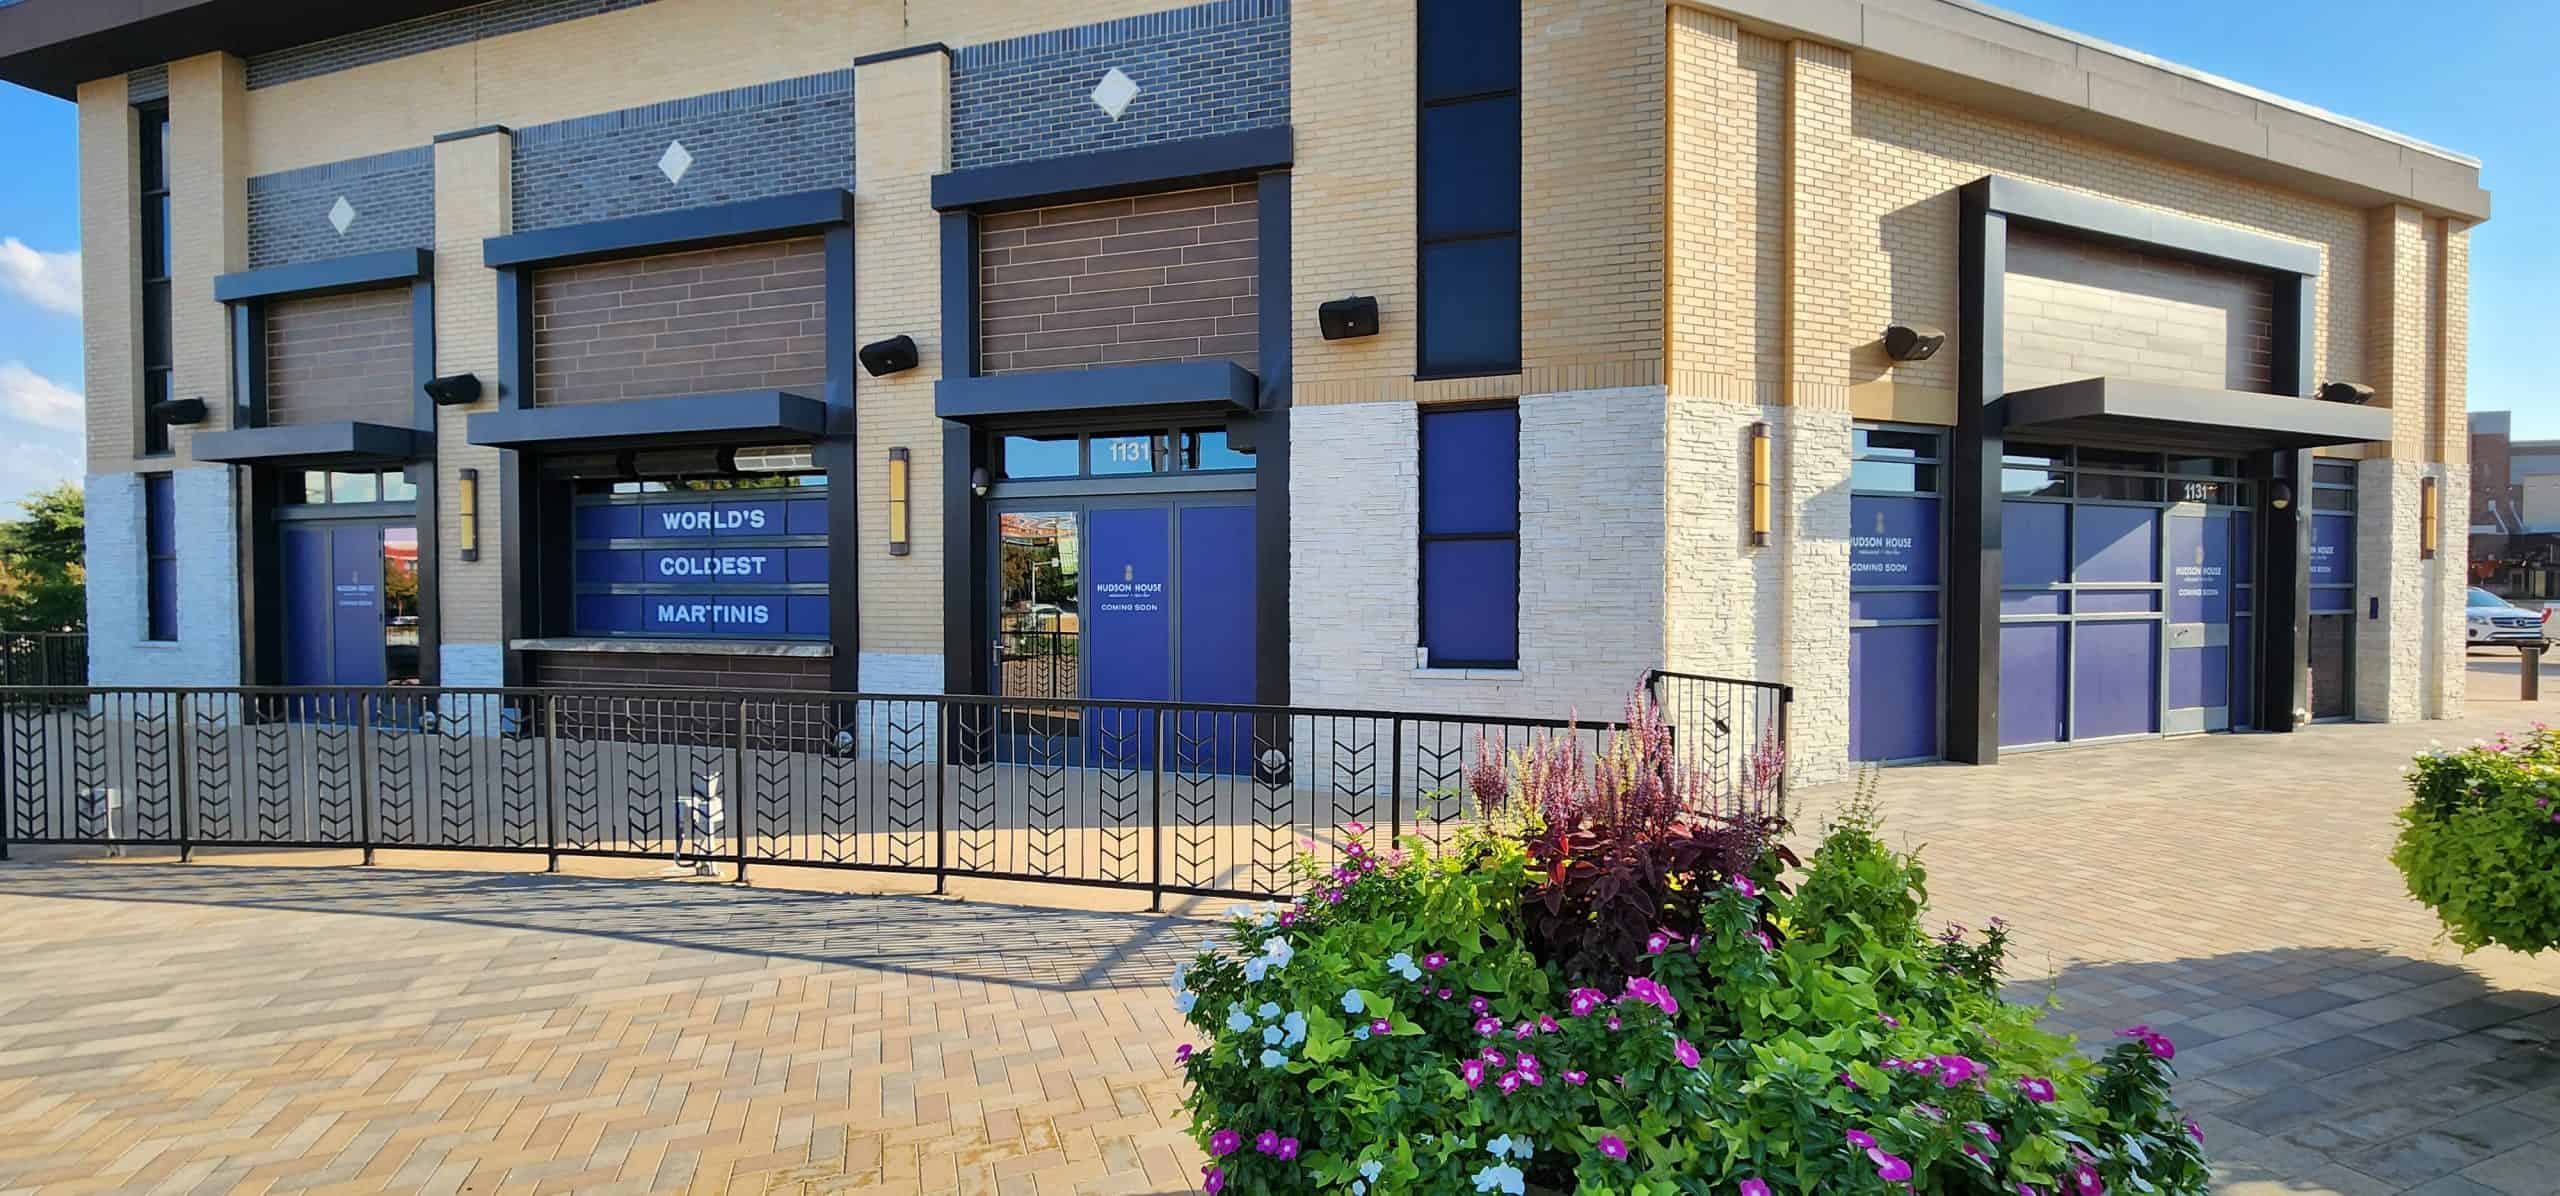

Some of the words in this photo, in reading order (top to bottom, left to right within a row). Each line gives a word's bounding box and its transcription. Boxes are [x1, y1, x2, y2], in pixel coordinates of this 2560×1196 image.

[1110, 442, 1150, 463] 1131
[2184, 483, 2207, 500] 1131
[662, 509, 765, 530] WORLD'S
[1885, 537, 1912, 548] HOUSE
[660, 556, 767, 575] COLDEST
[1851, 563, 1883, 572] COMING
[1885, 563, 1907, 572] SOON
[1097, 583, 1132, 592] HUDSON
[1134, 583, 1162, 592] HOUSE
[658, 604, 769, 624] MARTINIS
[1101, 603, 1133, 611] COMING
[1134, 603, 1158, 611] SOON
